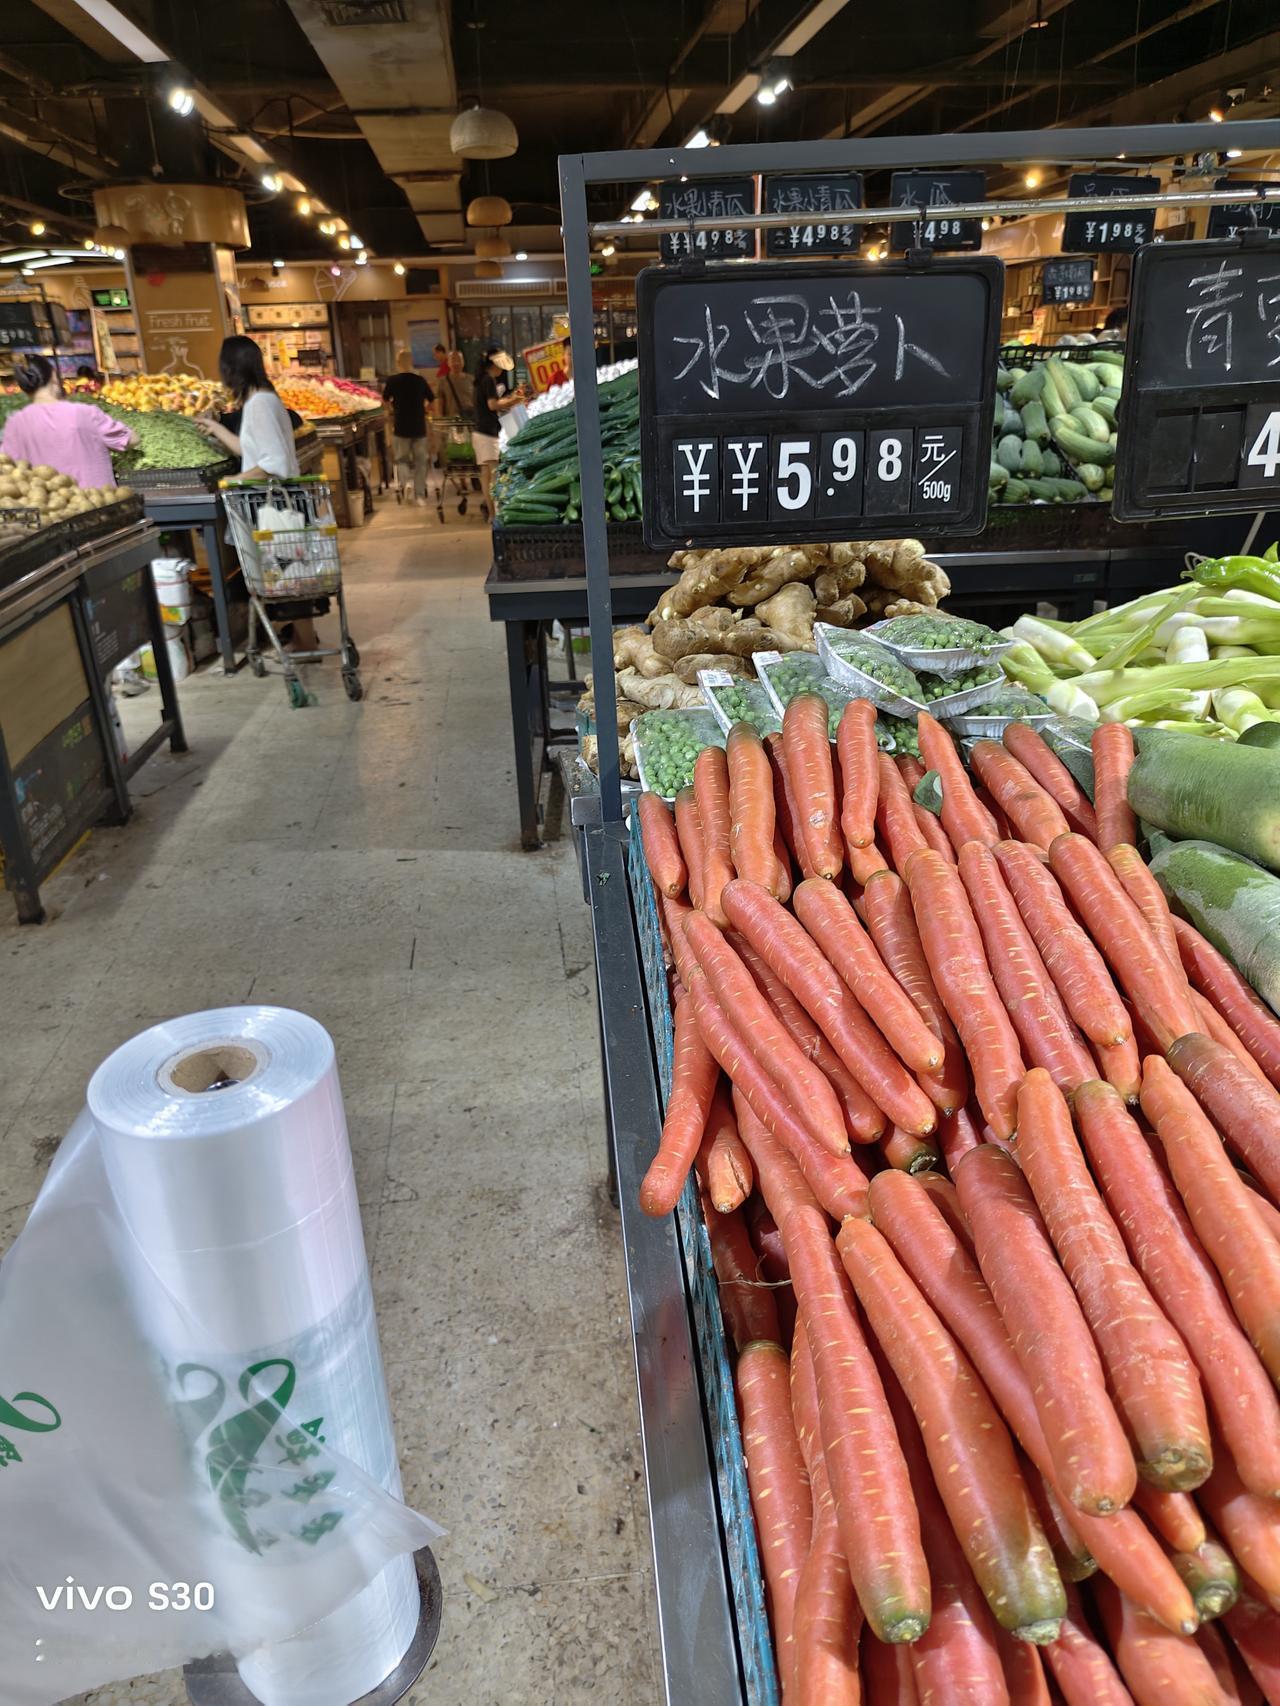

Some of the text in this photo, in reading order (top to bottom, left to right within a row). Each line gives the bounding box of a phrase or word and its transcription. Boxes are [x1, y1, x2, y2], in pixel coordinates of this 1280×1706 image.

[1085, 221, 1133, 243] ¥1.98
[149, 313, 209, 329] Fresh fruit
[673, 291, 952, 399] 水果萝卜
